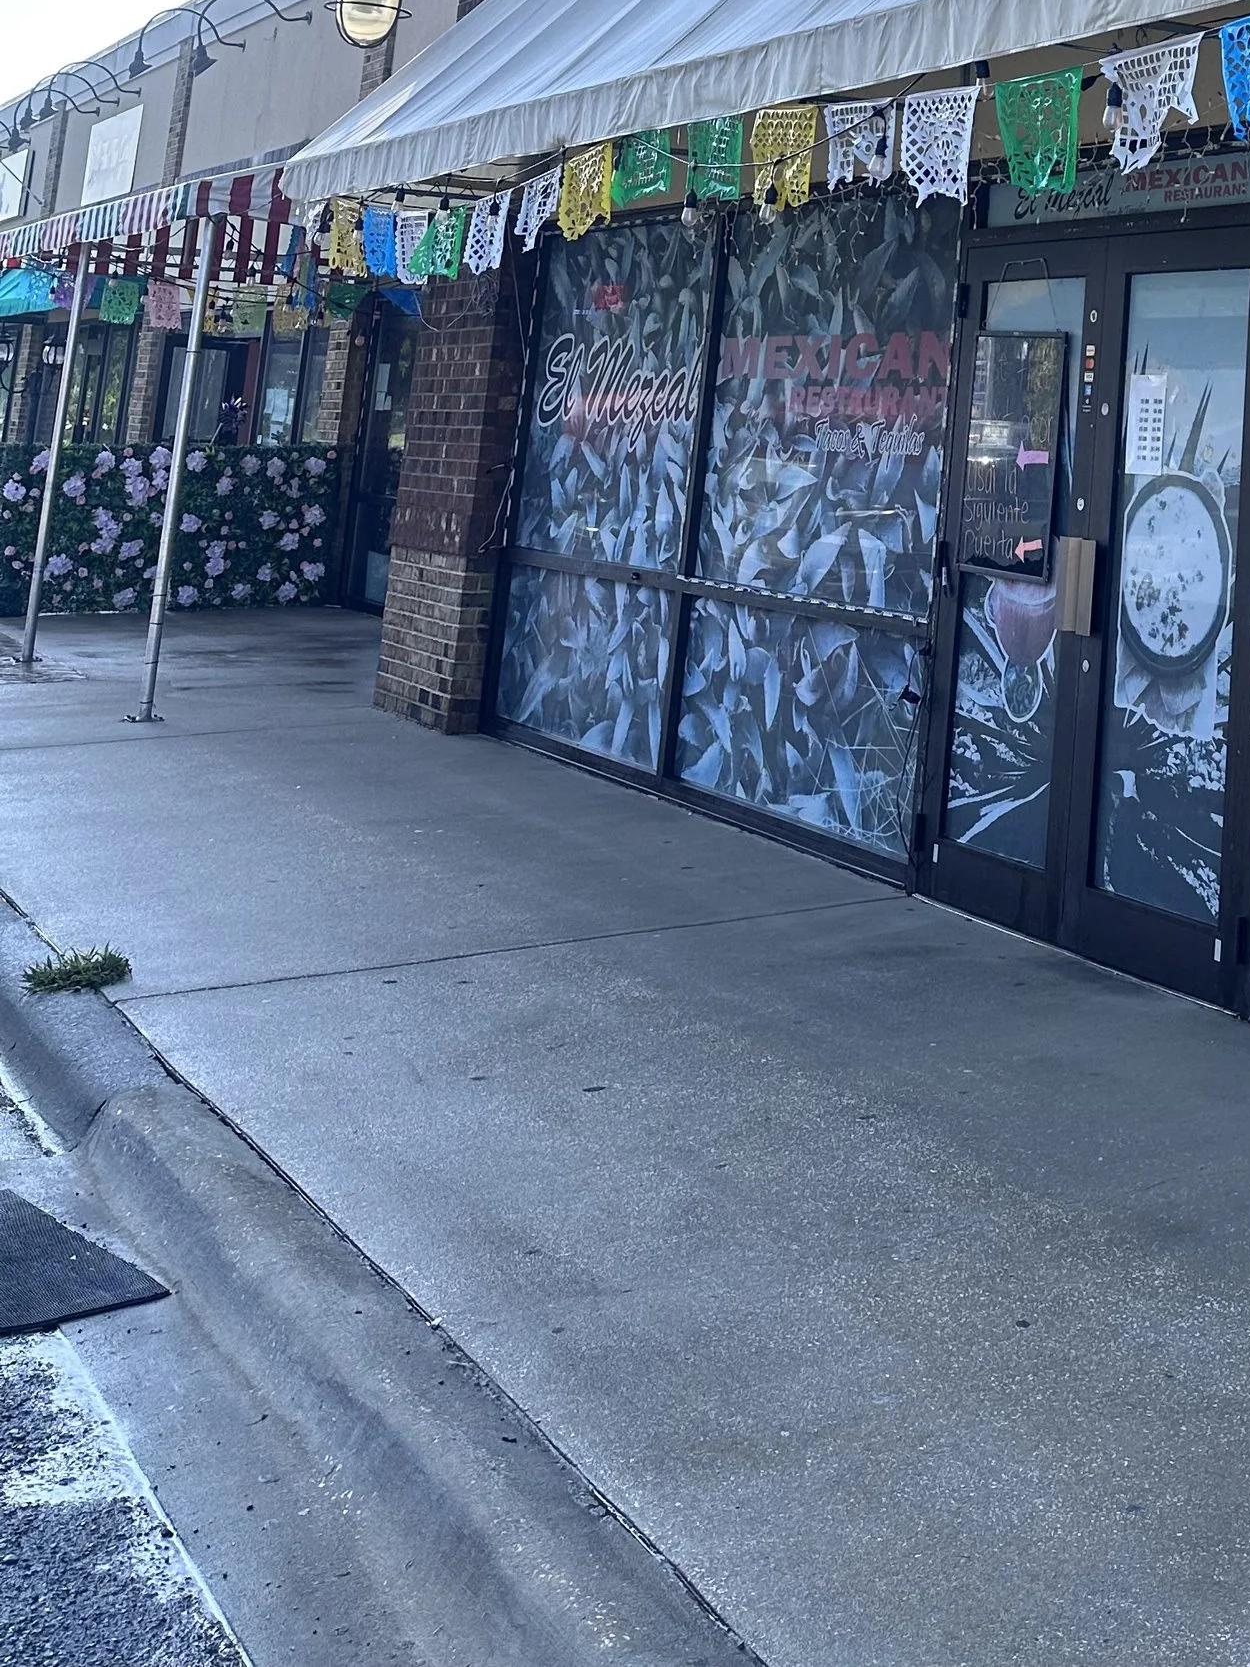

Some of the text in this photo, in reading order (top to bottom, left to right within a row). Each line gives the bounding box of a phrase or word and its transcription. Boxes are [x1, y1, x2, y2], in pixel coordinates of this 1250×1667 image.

[1124, 159, 1248, 193] MEXICAN
[721, 331, 951, 380] MEXICAN
[536, 333, 703, 453] El Mezcal
[814, 414, 926, 466] Tacos & Tequilas
[963, 529, 1013, 560] Puerta
